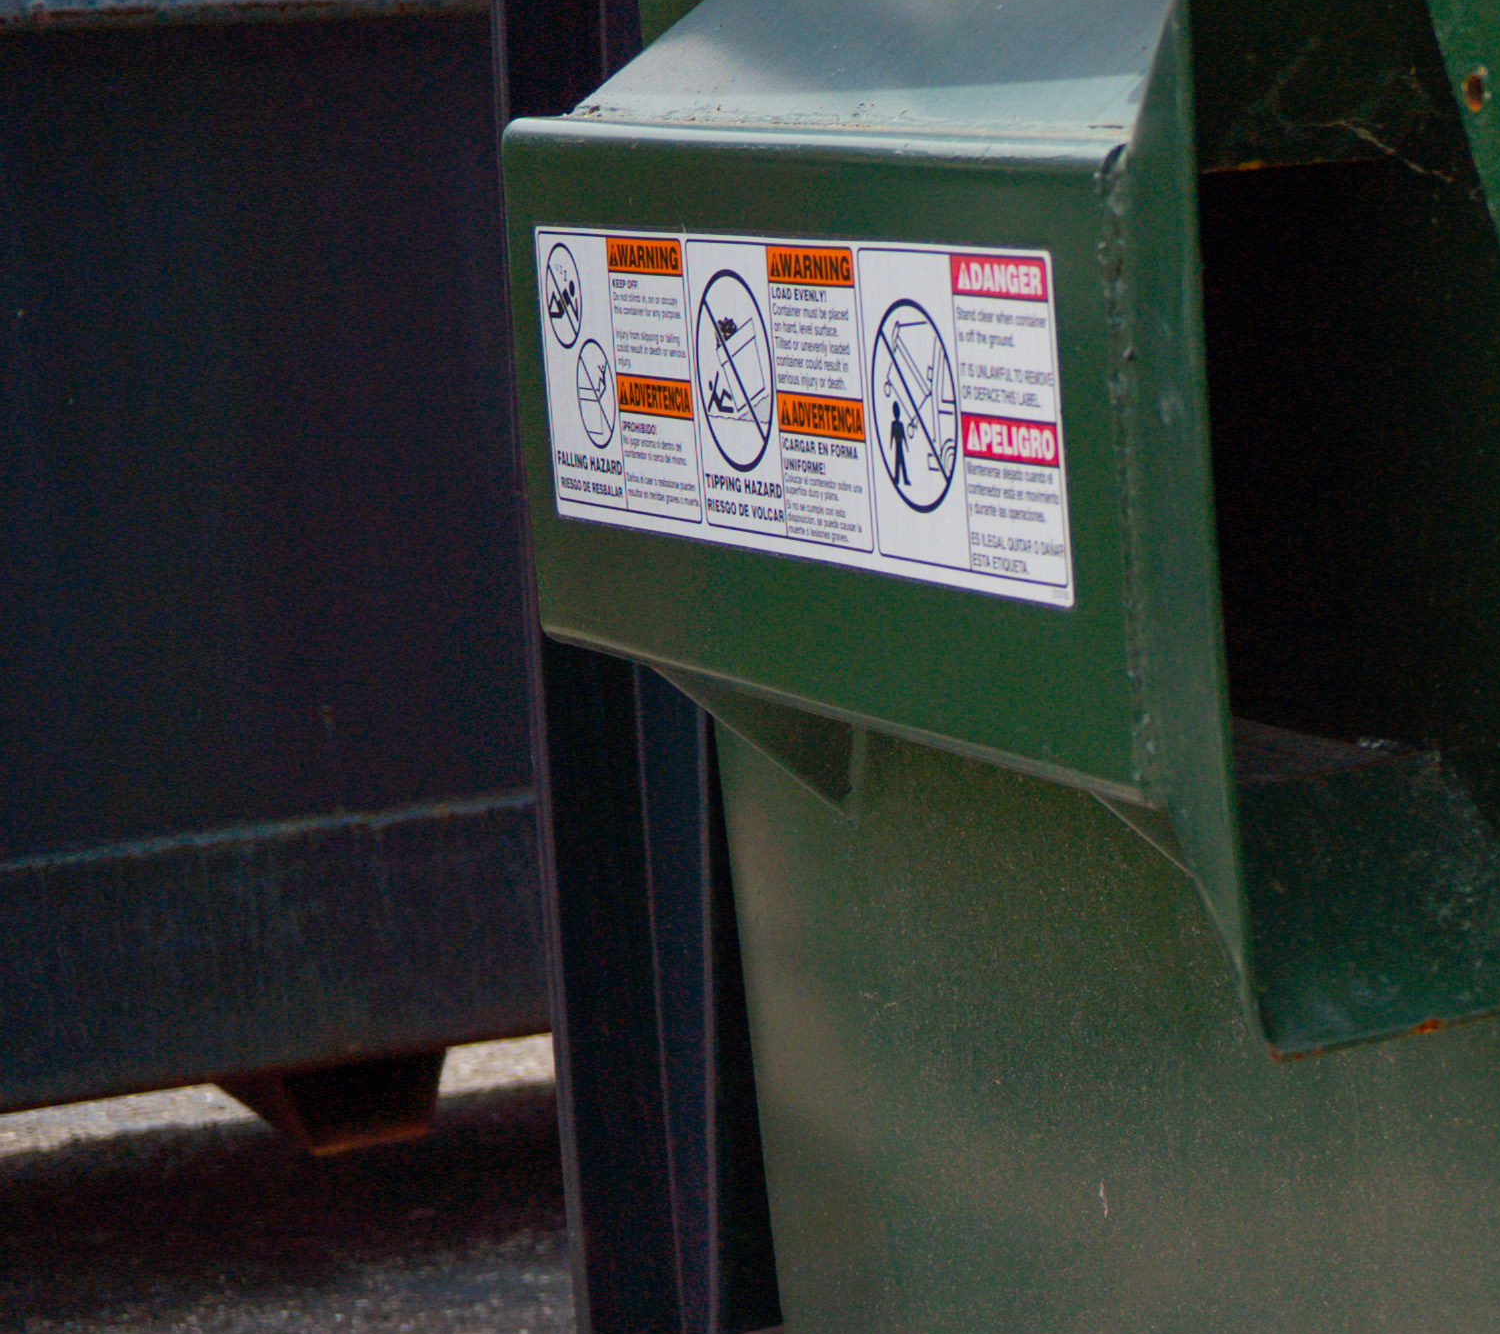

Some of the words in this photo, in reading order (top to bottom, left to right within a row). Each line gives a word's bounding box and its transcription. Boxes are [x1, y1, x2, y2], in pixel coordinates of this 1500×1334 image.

[617, 244, 679, 270] WARNING
[780, 253, 850, 281] WARNING
[969, 262, 1043, 296] DANGER
[771, 287, 792, 300] LOAD
[794, 289, 827, 303] EVENLY!
[773, 303, 801, 317] Container
[803, 308, 818, 319] must
[820, 307, 827, 319] be
[828, 308, 849, 322] placed
[776, 355, 804, 368] container
[805, 357, 822, 370] could
[824, 359, 841, 371] result
[843, 361, 849, 372] in
[630, 382, 691, 413] ADVERTENCIA
[792, 401, 863, 434] ADVERTENCIA
[818, 442, 828, 456] EN
[831, 444, 859, 460] FORMA
[979, 422, 1055, 460] PELIGRO
[557, 450, 588, 469] FALLING
[590, 455, 622, 475] HAZARD
[783, 457, 826, 475] UNIFORME!
[561, 476, 581, 491] RIESGO
[583, 480, 591, 492] DE
[592, 482, 623, 498] RESBALAR
[705, 473, 741, 493] TIPPING
[744, 478, 782, 499] HAZARD
[707, 498, 736, 516] RIESGO
[739, 503, 749, 518] DE
[751, 504, 785, 523] VOLCAR
